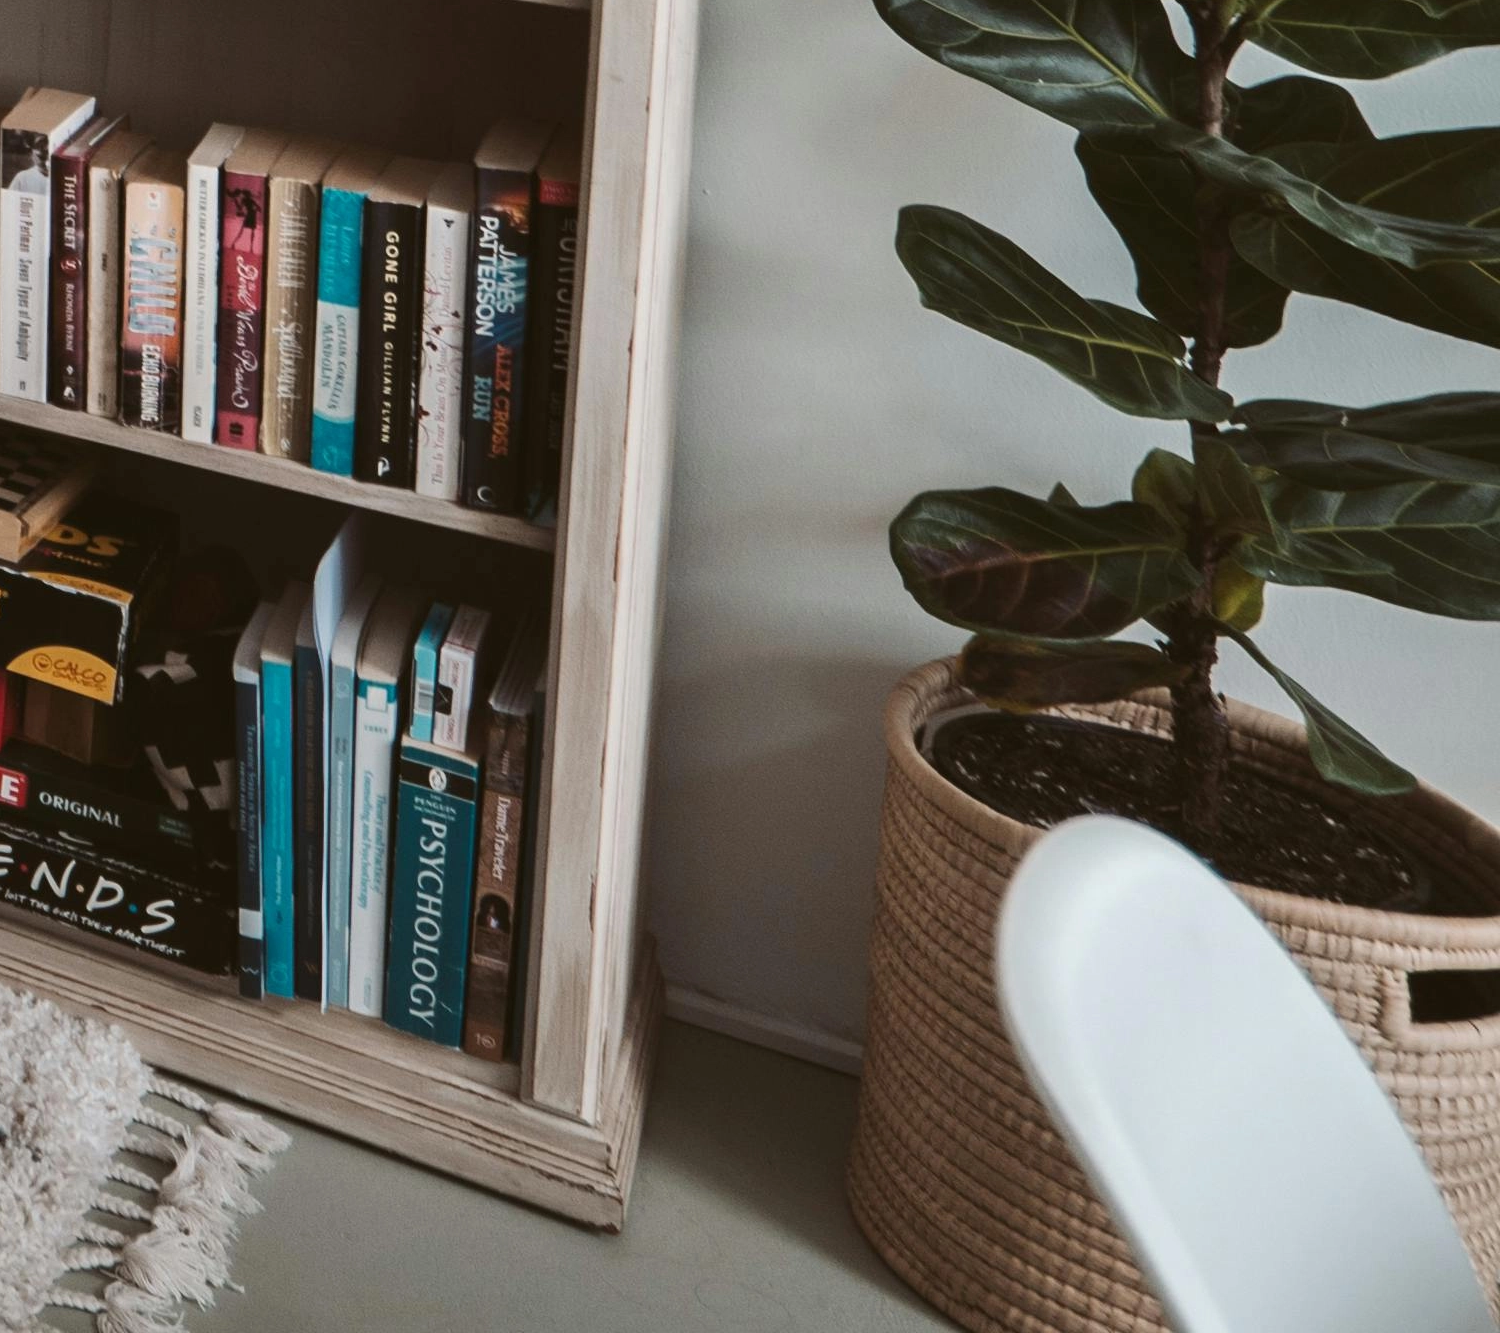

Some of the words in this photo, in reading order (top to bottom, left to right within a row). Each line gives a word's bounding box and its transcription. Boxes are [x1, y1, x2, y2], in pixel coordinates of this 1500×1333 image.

[63, 174, 76, 199] THE
[62, 203, 76, 249] SECRET
[383, 230, 400, 283] GONE
[474, 216, 499, 337] PATTERSON
[496, 245, 517, 314] JAMES
[383, 292, 398, 333] GIRL
[381, 341, 394, 396] GILLIAN
[493, 345, 512, 390] ALEX
[472, 375, 491, 421] RUN
[380, 401, 392, 443] FLYNN
[38, 790, 124, 830] ORIGINAL
[415, 796, 457, 817] PENGUIN
[408, 817, 447, 1029] PSYCHOLOGY
